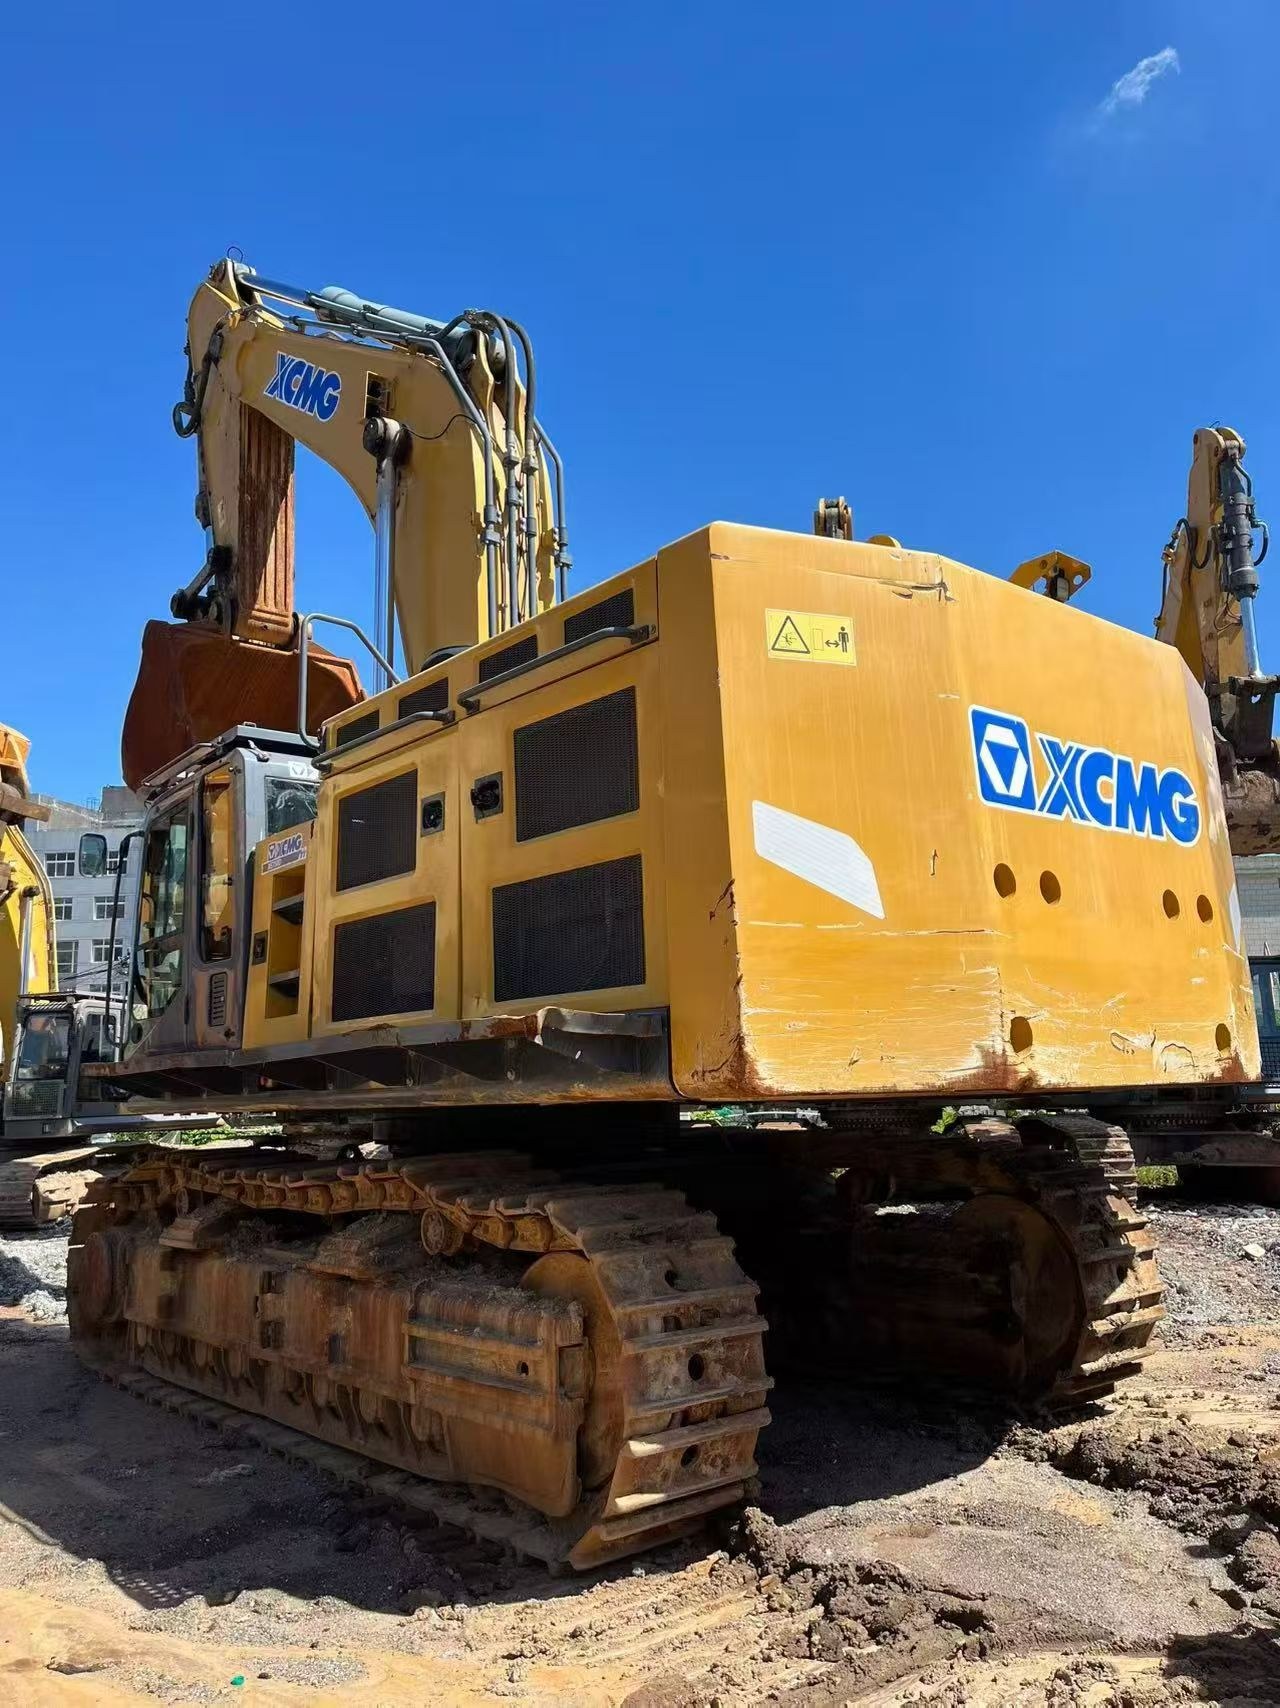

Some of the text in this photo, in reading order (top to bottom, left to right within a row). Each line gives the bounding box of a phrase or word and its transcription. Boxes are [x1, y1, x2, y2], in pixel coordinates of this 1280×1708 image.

[264, 351, 342, 422] XCMG
[1036, 733, 1201, 846] XCMG
[275, 833, 302, 857] XCMG
